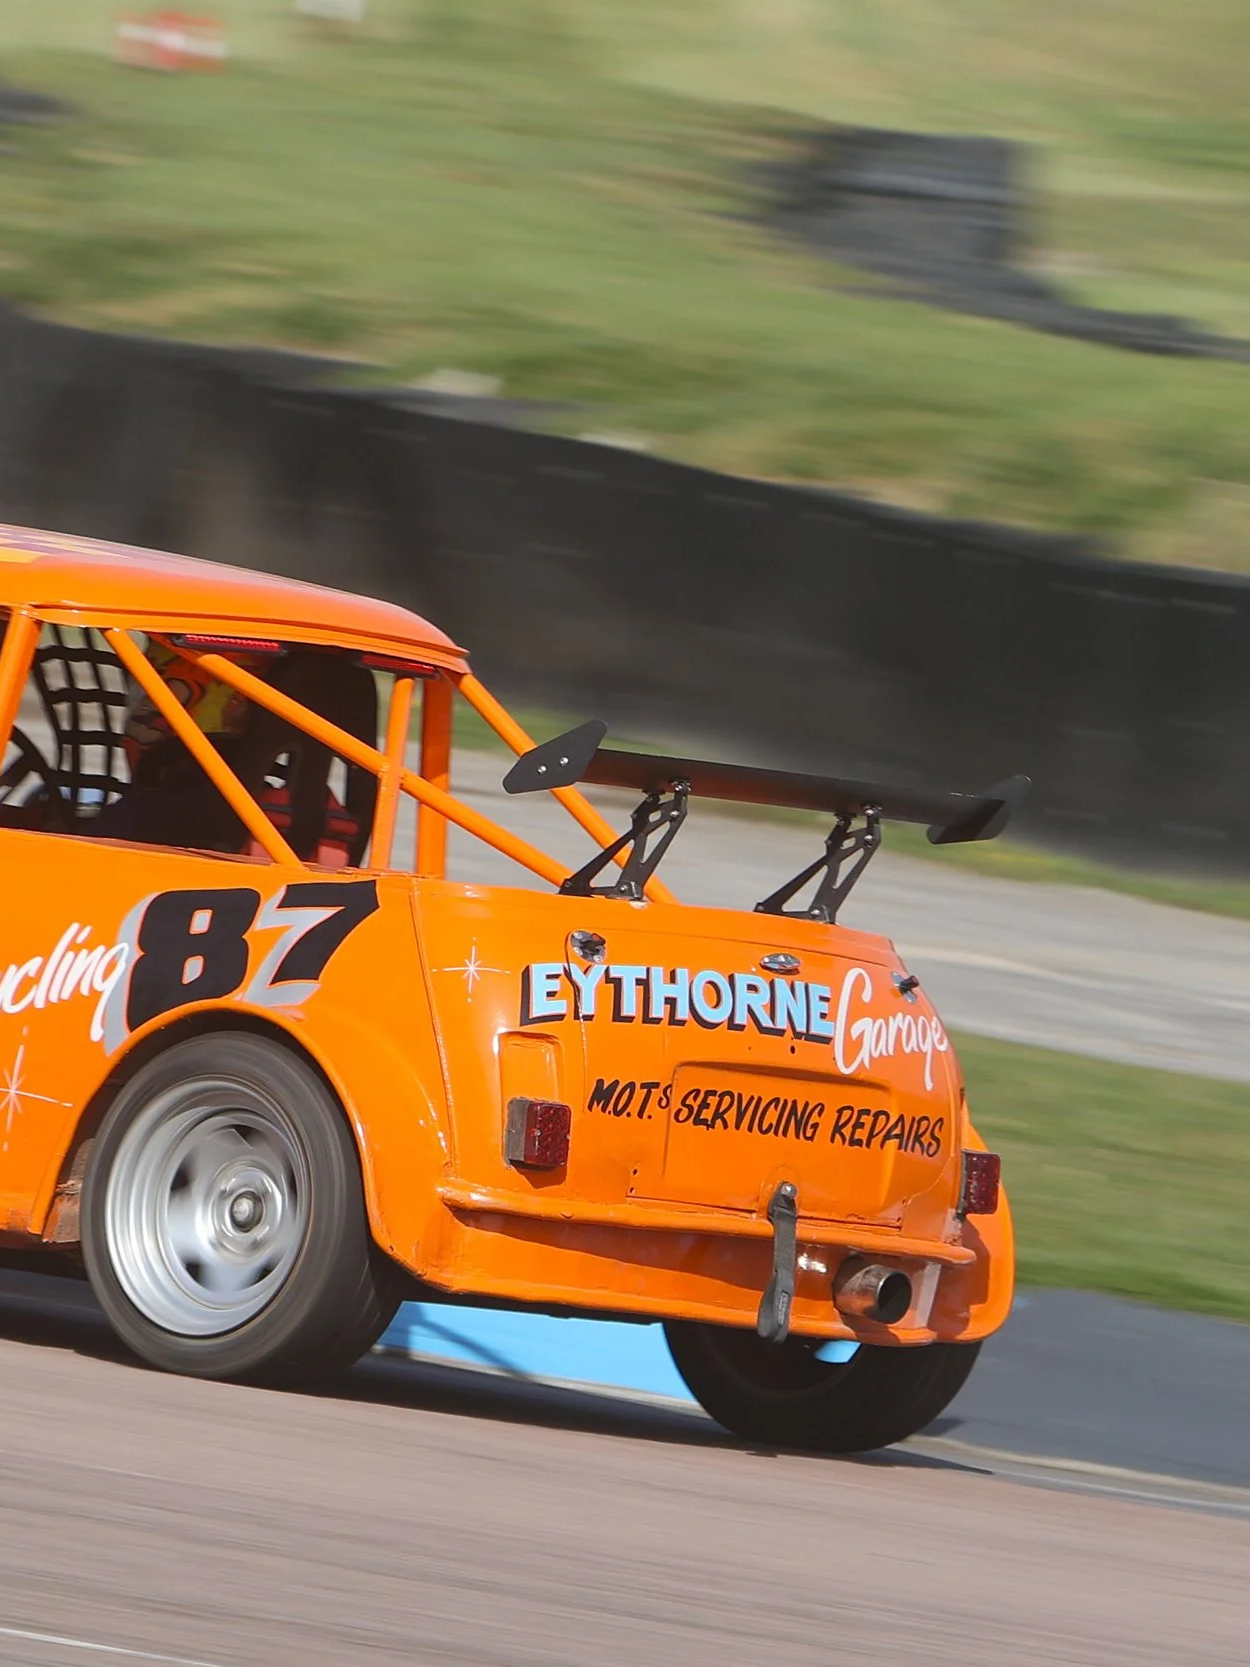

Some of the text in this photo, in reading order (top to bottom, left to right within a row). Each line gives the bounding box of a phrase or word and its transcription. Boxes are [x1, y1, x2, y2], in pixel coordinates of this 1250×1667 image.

[104, 880, 380, 1056] 87
[521, 962, 949, 1091] EYTHORNE Garage
[674, 1088, 826, 1142] SERVICING
[830, 1105, 944, 1158] REPAIRS
